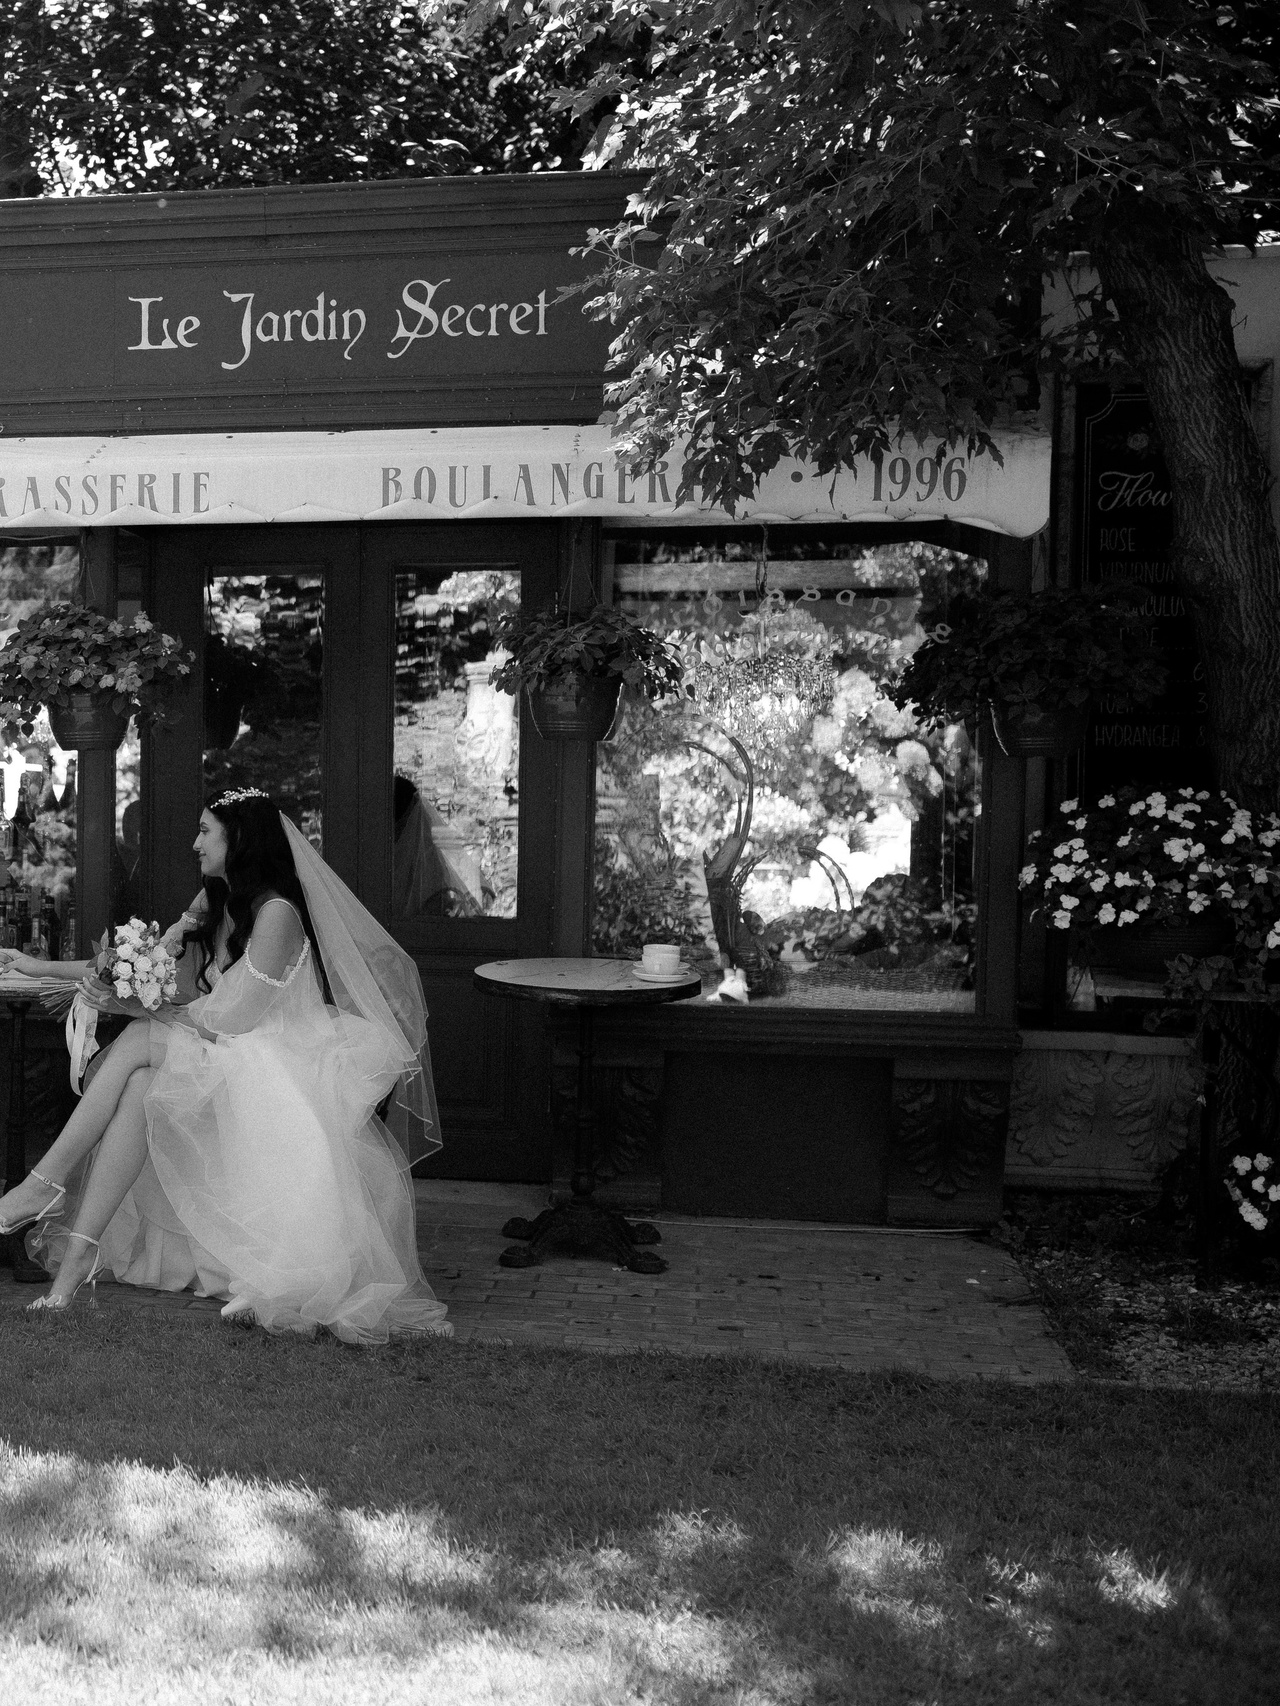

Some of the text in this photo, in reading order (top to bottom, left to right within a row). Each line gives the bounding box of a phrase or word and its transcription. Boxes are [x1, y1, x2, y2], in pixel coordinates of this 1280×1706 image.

[127, 278, 551, 370] Le Jardin Secret
[380, 460, 718, 509] BOULANGER
[872, 456, 968, 502] 1996
[1099, 526, 1137, 552] ROSE
[1094, 724, 1181, 748] HYDRANGEA
